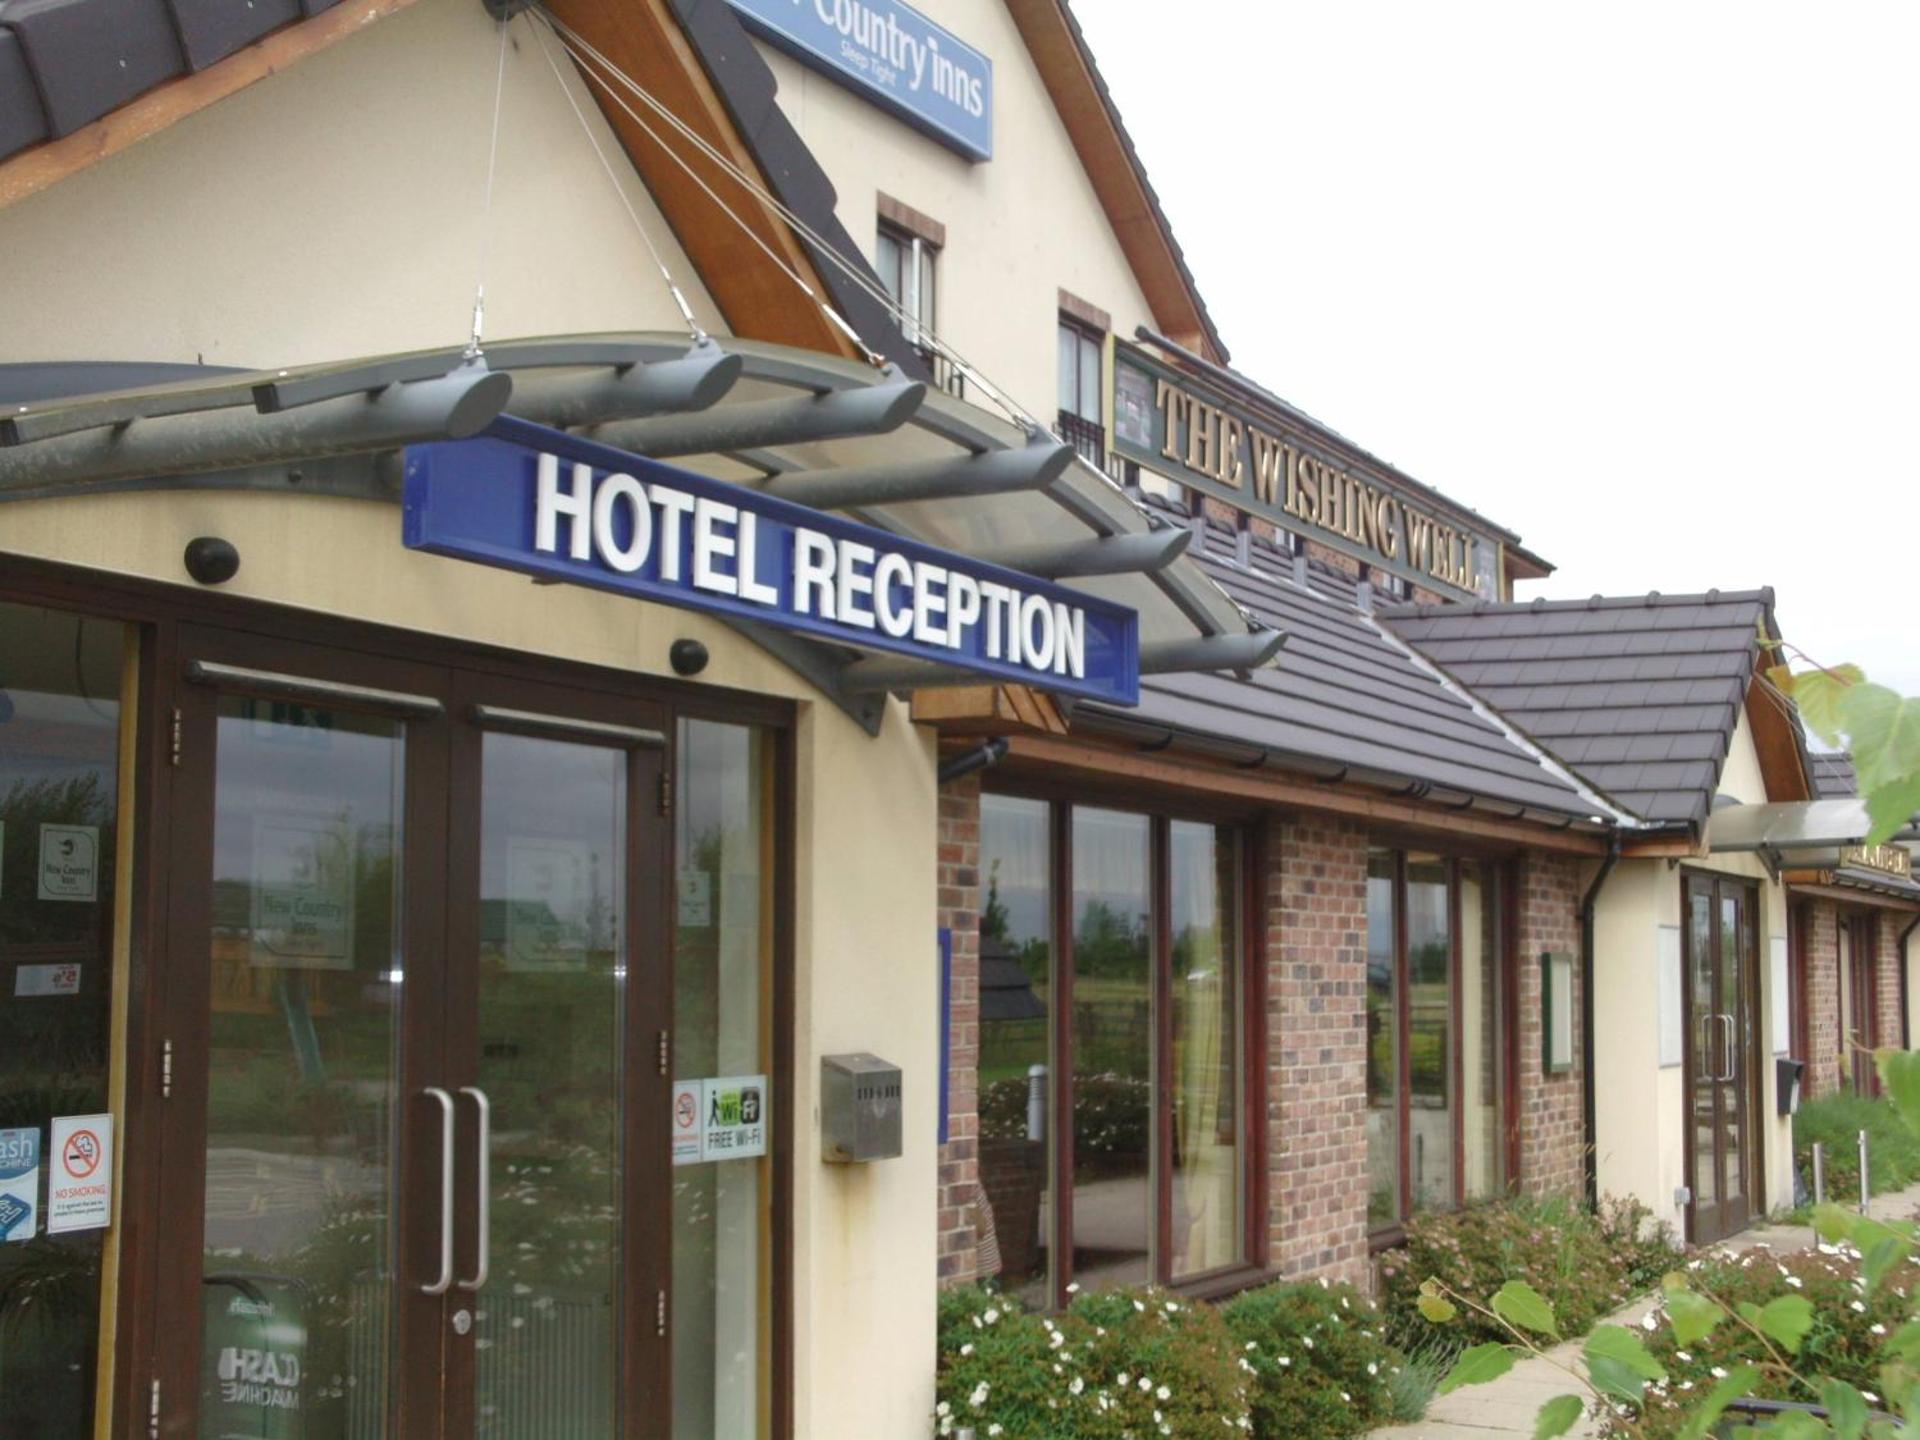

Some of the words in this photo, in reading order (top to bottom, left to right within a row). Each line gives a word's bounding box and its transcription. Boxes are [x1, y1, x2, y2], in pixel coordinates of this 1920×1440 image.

[927, 36, 984, 118] inns
[1156, 378, 1244, 490] THE
[1247, 425, 1400, 560] WISHING
[1402, 503, 1481, 594] WELL
[535, 453, 778, 606] HOTEL
[793, 526, 1085, 680] RECEPTION
[708, 1131, 733, 1150] FREE
[56, 1188, 67, 1199] NO
[68, 1184, 105, 1198] SMOKING
